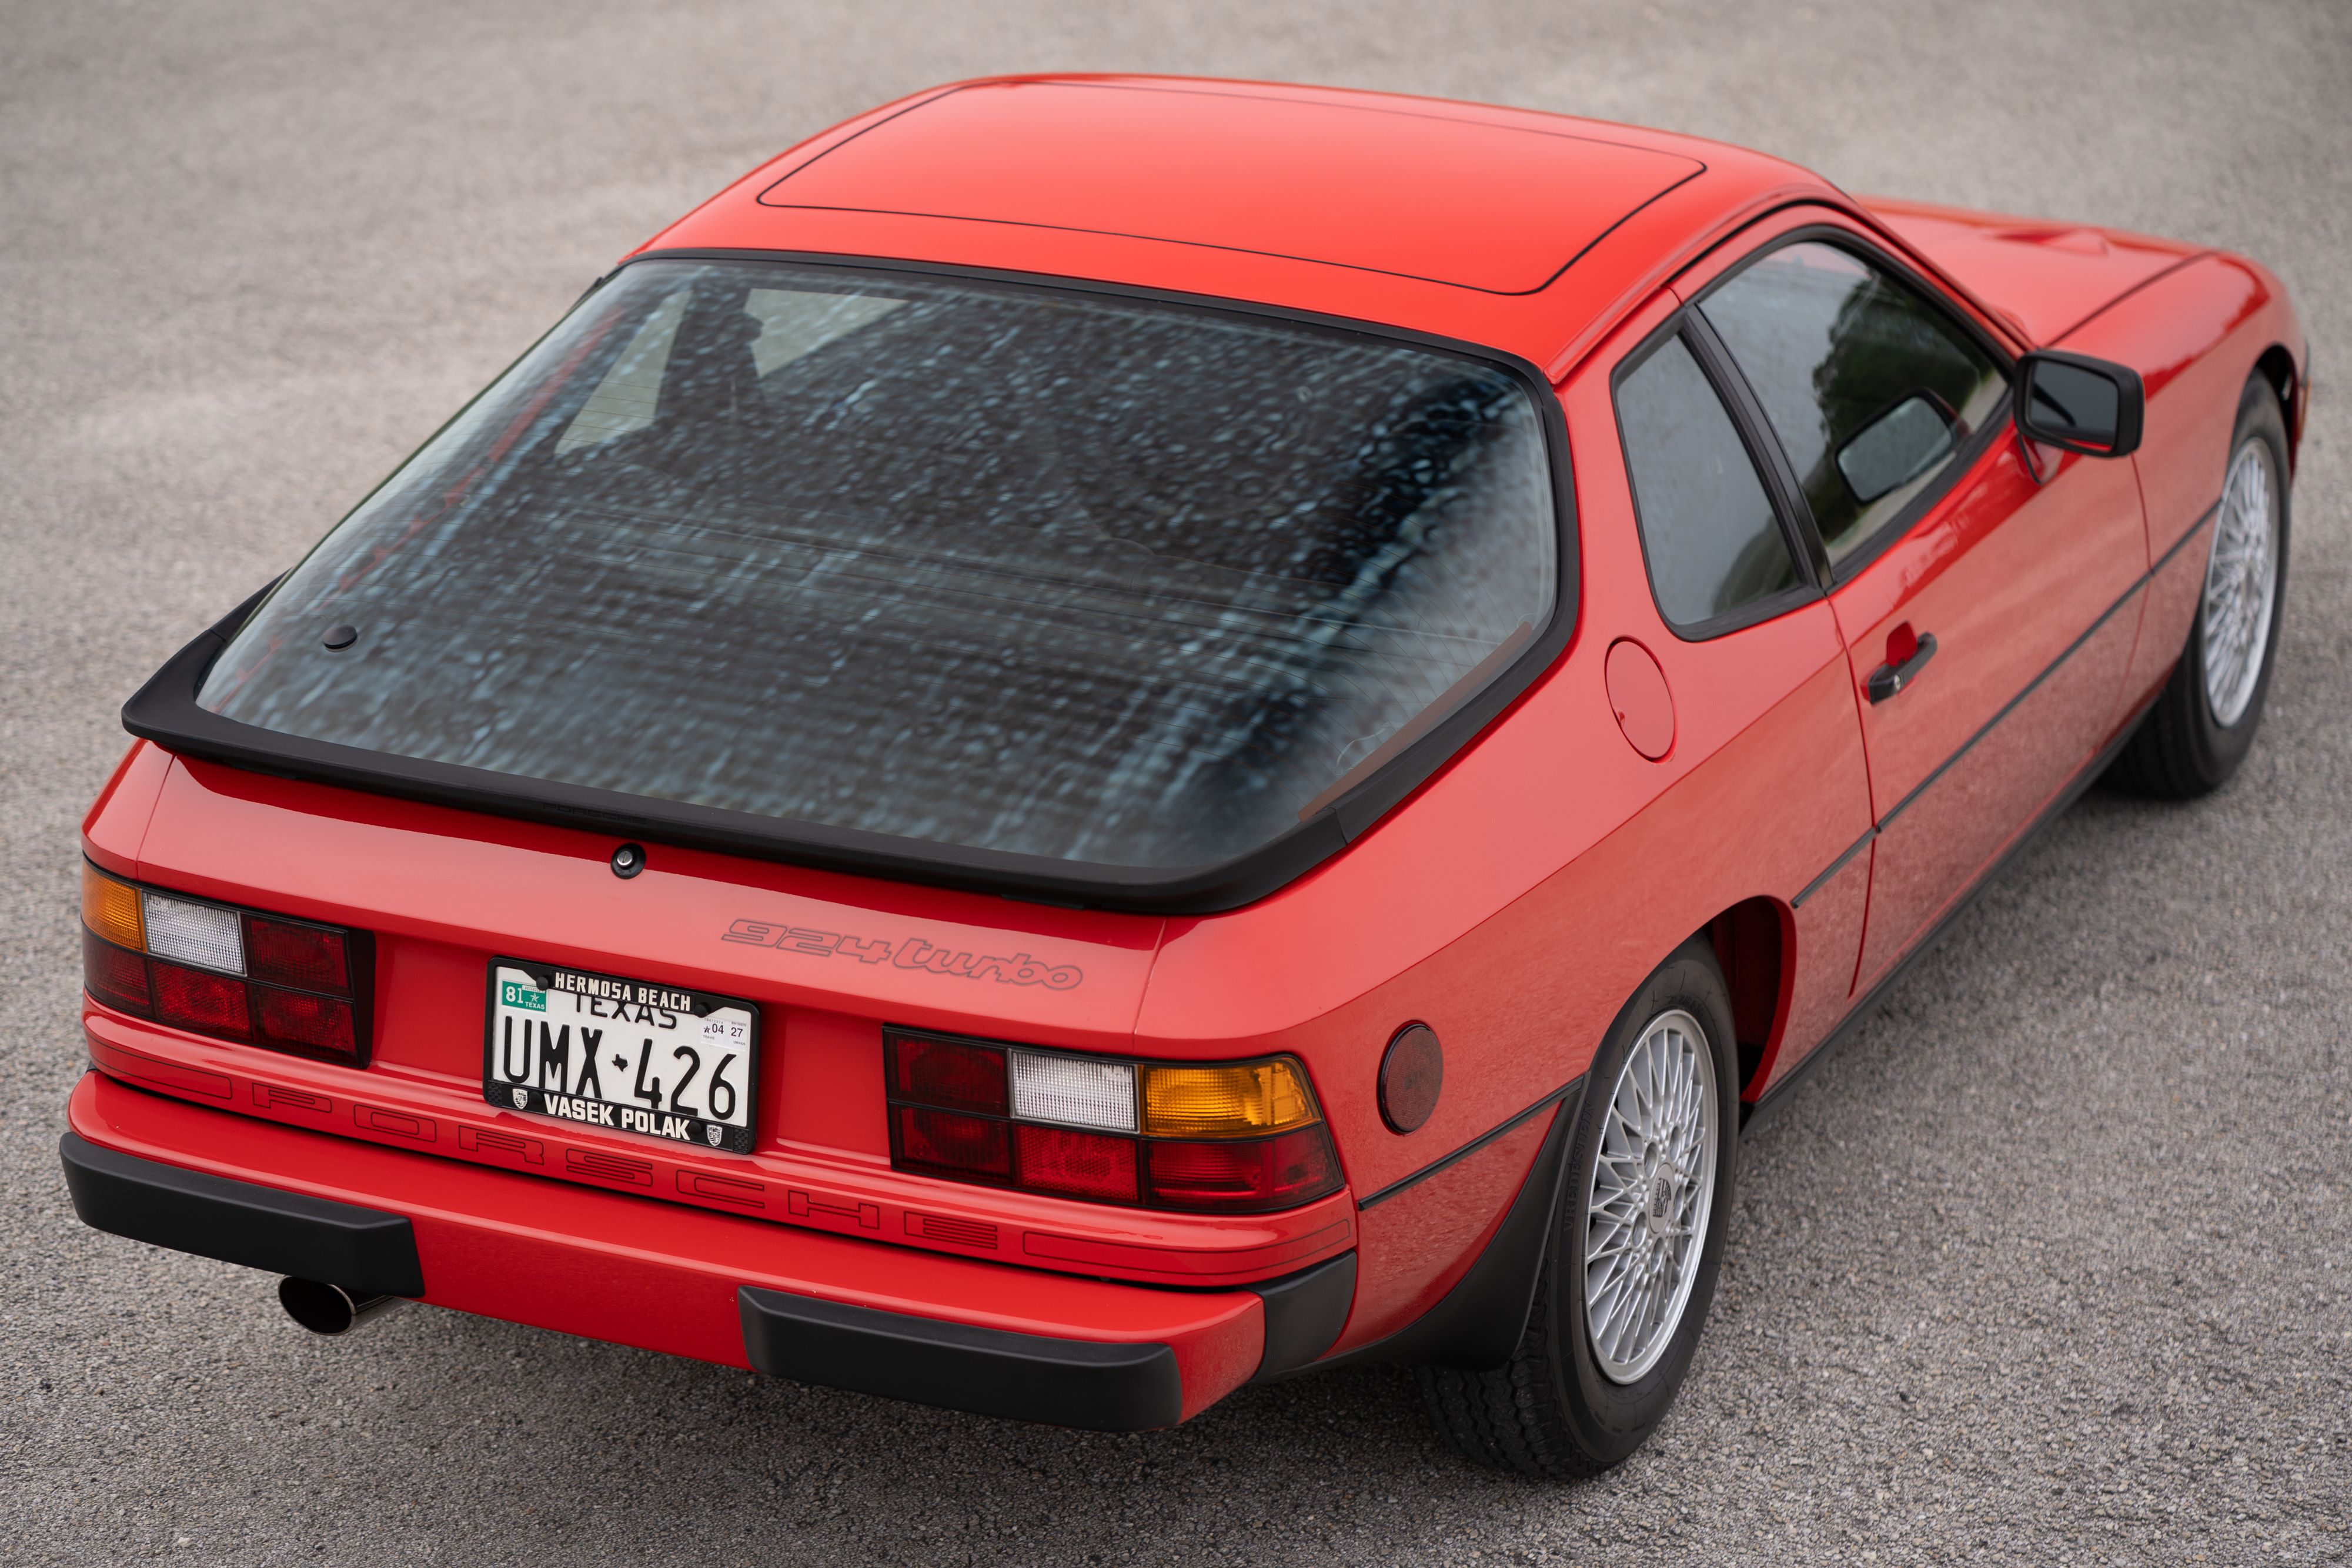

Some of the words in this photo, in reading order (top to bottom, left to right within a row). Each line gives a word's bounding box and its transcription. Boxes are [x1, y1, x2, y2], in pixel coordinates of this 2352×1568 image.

[542, 802, 646, 825] PORSCHE
[721, 919, 892, 964] 924
[893, 937, 1083, 991] turbo
[506, 986, 523, 1004] 81
[524, 1001, 545, 1009] TEXAS
[556, 972, 632, 1001] HERMOSA
[639, 987, 691, 1011] BEACH
[576, 994, 677, 1029] TEXAS
[712, 1023, 724, 1034] 04
[730, 1027, 743, 1038] 27
[544, 1094, 614, 1126] VASEK
[622, 1108, 690, 1141] POLAK
[252, 1082, 998, 1250] PORSCHE
[1563, 1099, 1595, 1233] VREDESTEIN
